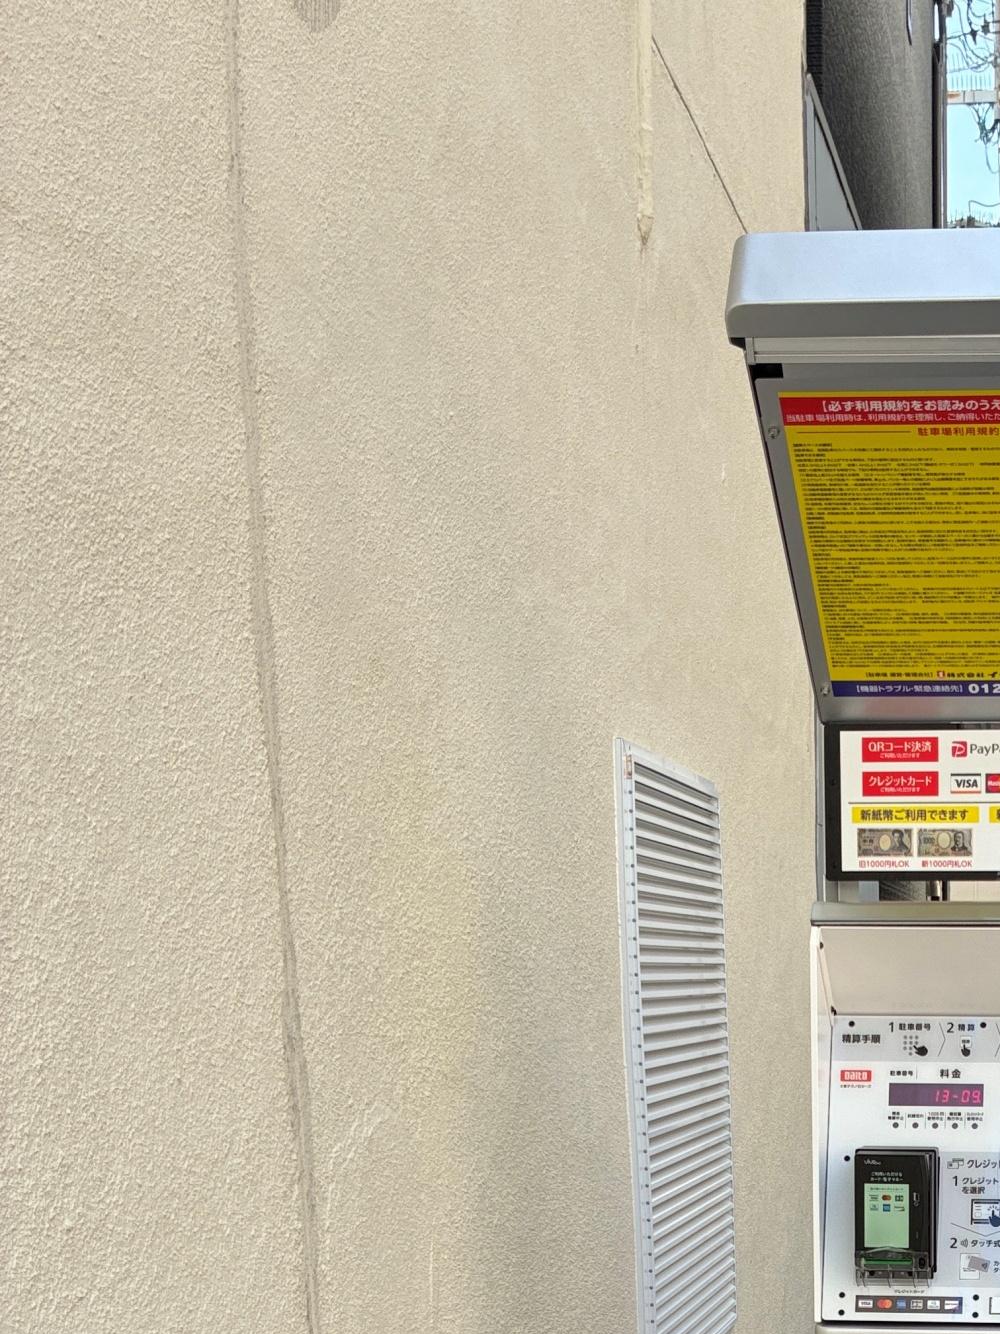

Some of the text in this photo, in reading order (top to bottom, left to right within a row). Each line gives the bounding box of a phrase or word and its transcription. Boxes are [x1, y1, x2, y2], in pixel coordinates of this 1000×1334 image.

[917, 427, 1000, 436] 駐車場利用規約
[868, 741, 932, 752] QRコード決済
[869, 775, 932, 787] クレジットカード
[955, 779, 979, 788] VISA
[860, 809, 969, 821] 新紙幣ご利用できます
[858, 860, 910, 868] 旧1000円札OK
[921, 860, 973, 868] 新1000円札OK
[946, 1022, 955, 1033] 2
[842, 1034, 881, 1044] 精算手順
[939, 1069, 961, 1079] 料金
[952, 1175, 958, 1186] 1
[961, 1186, 986, 1194] を選択
[949, 1237, 958, 1249] 2
